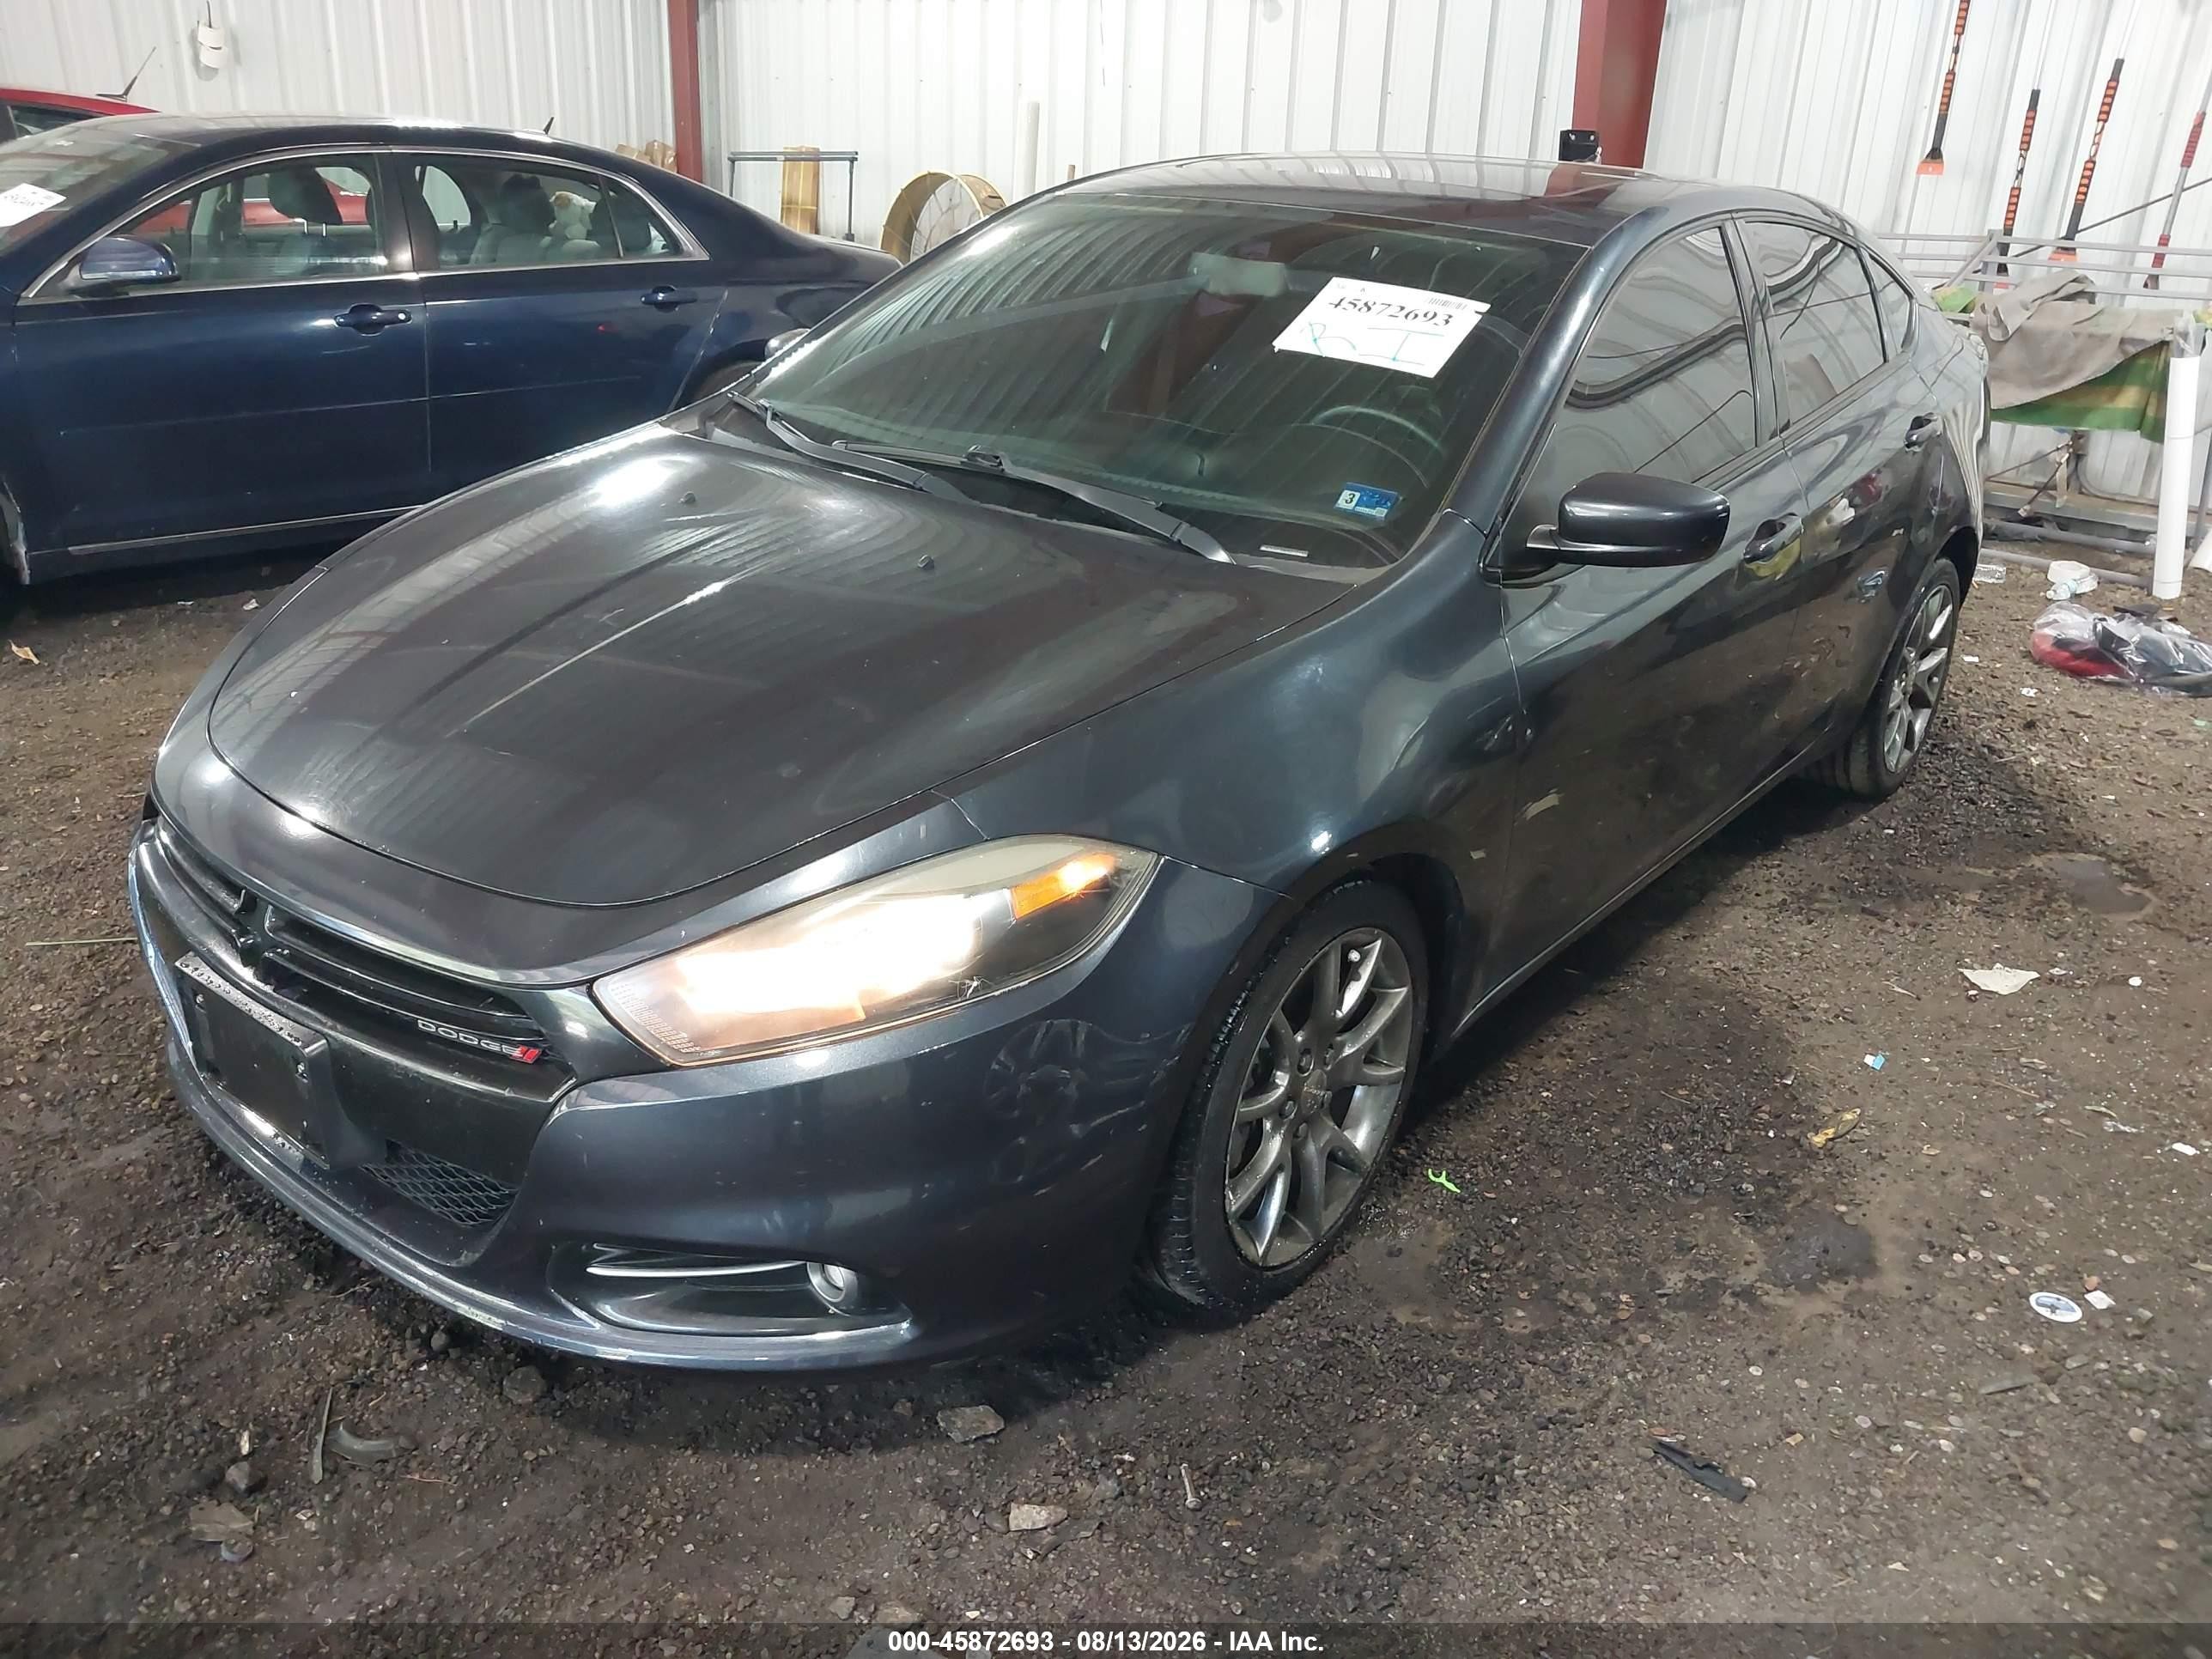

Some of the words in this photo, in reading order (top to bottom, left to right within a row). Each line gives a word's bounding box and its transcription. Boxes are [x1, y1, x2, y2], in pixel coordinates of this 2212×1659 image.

[1328, 296, 1454, 326] 45872693
[1345, 493, 1355, 504] 3
[417, 1019, 523, 1058] DODGE
